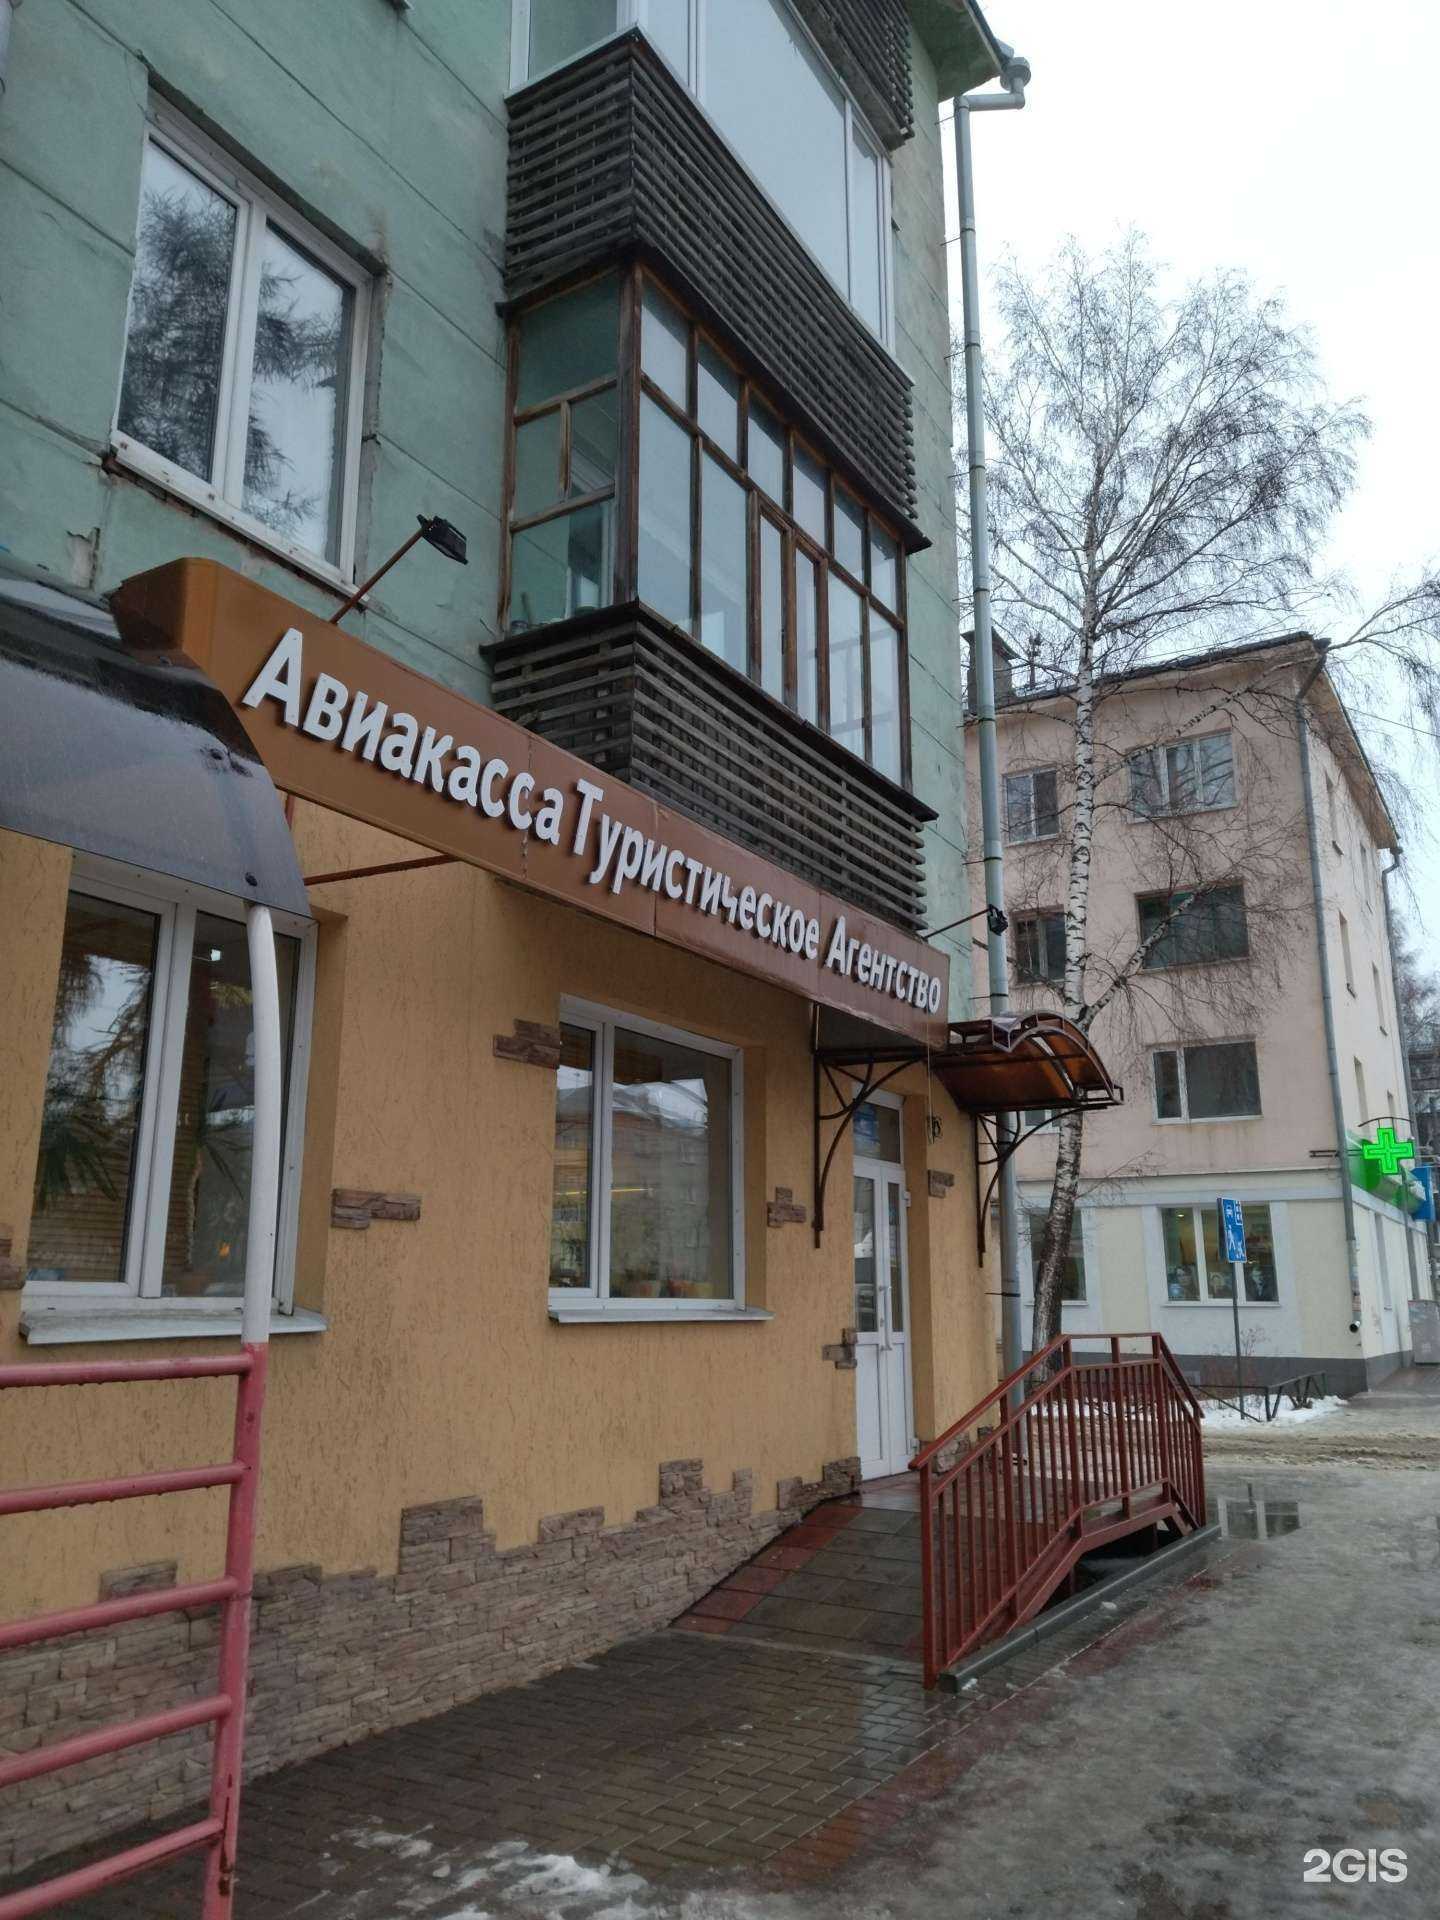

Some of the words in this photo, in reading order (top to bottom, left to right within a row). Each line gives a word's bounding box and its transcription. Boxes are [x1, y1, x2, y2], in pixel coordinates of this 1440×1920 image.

[241, 627, 564, 846] Авиакасса
[572, 778, 820, 960] Туристическое
[825, 915, 942, 1014] Агентство
